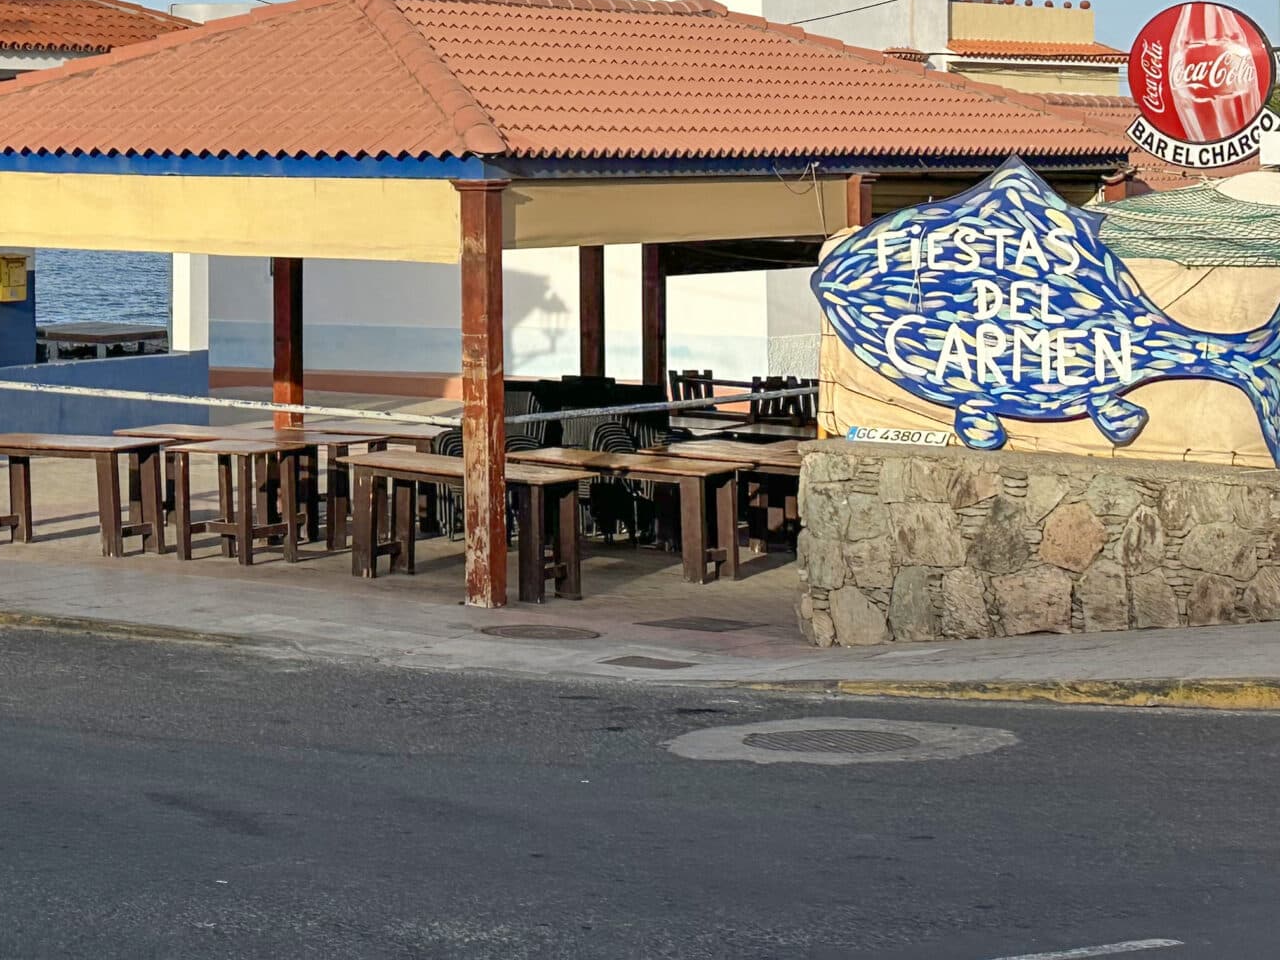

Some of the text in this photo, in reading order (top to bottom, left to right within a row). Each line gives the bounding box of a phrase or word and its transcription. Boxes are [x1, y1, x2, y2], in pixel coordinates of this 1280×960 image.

[1141, 38, 1165, 113] Coca-Cola
[1132, 113, 1274, 166] BAR EL CHARCO
[972, 279, 1065, 324] DEL
[885, 314, 1133, 386] CARMEN
[856, 428, 947, 445] GC 4380 CJ
